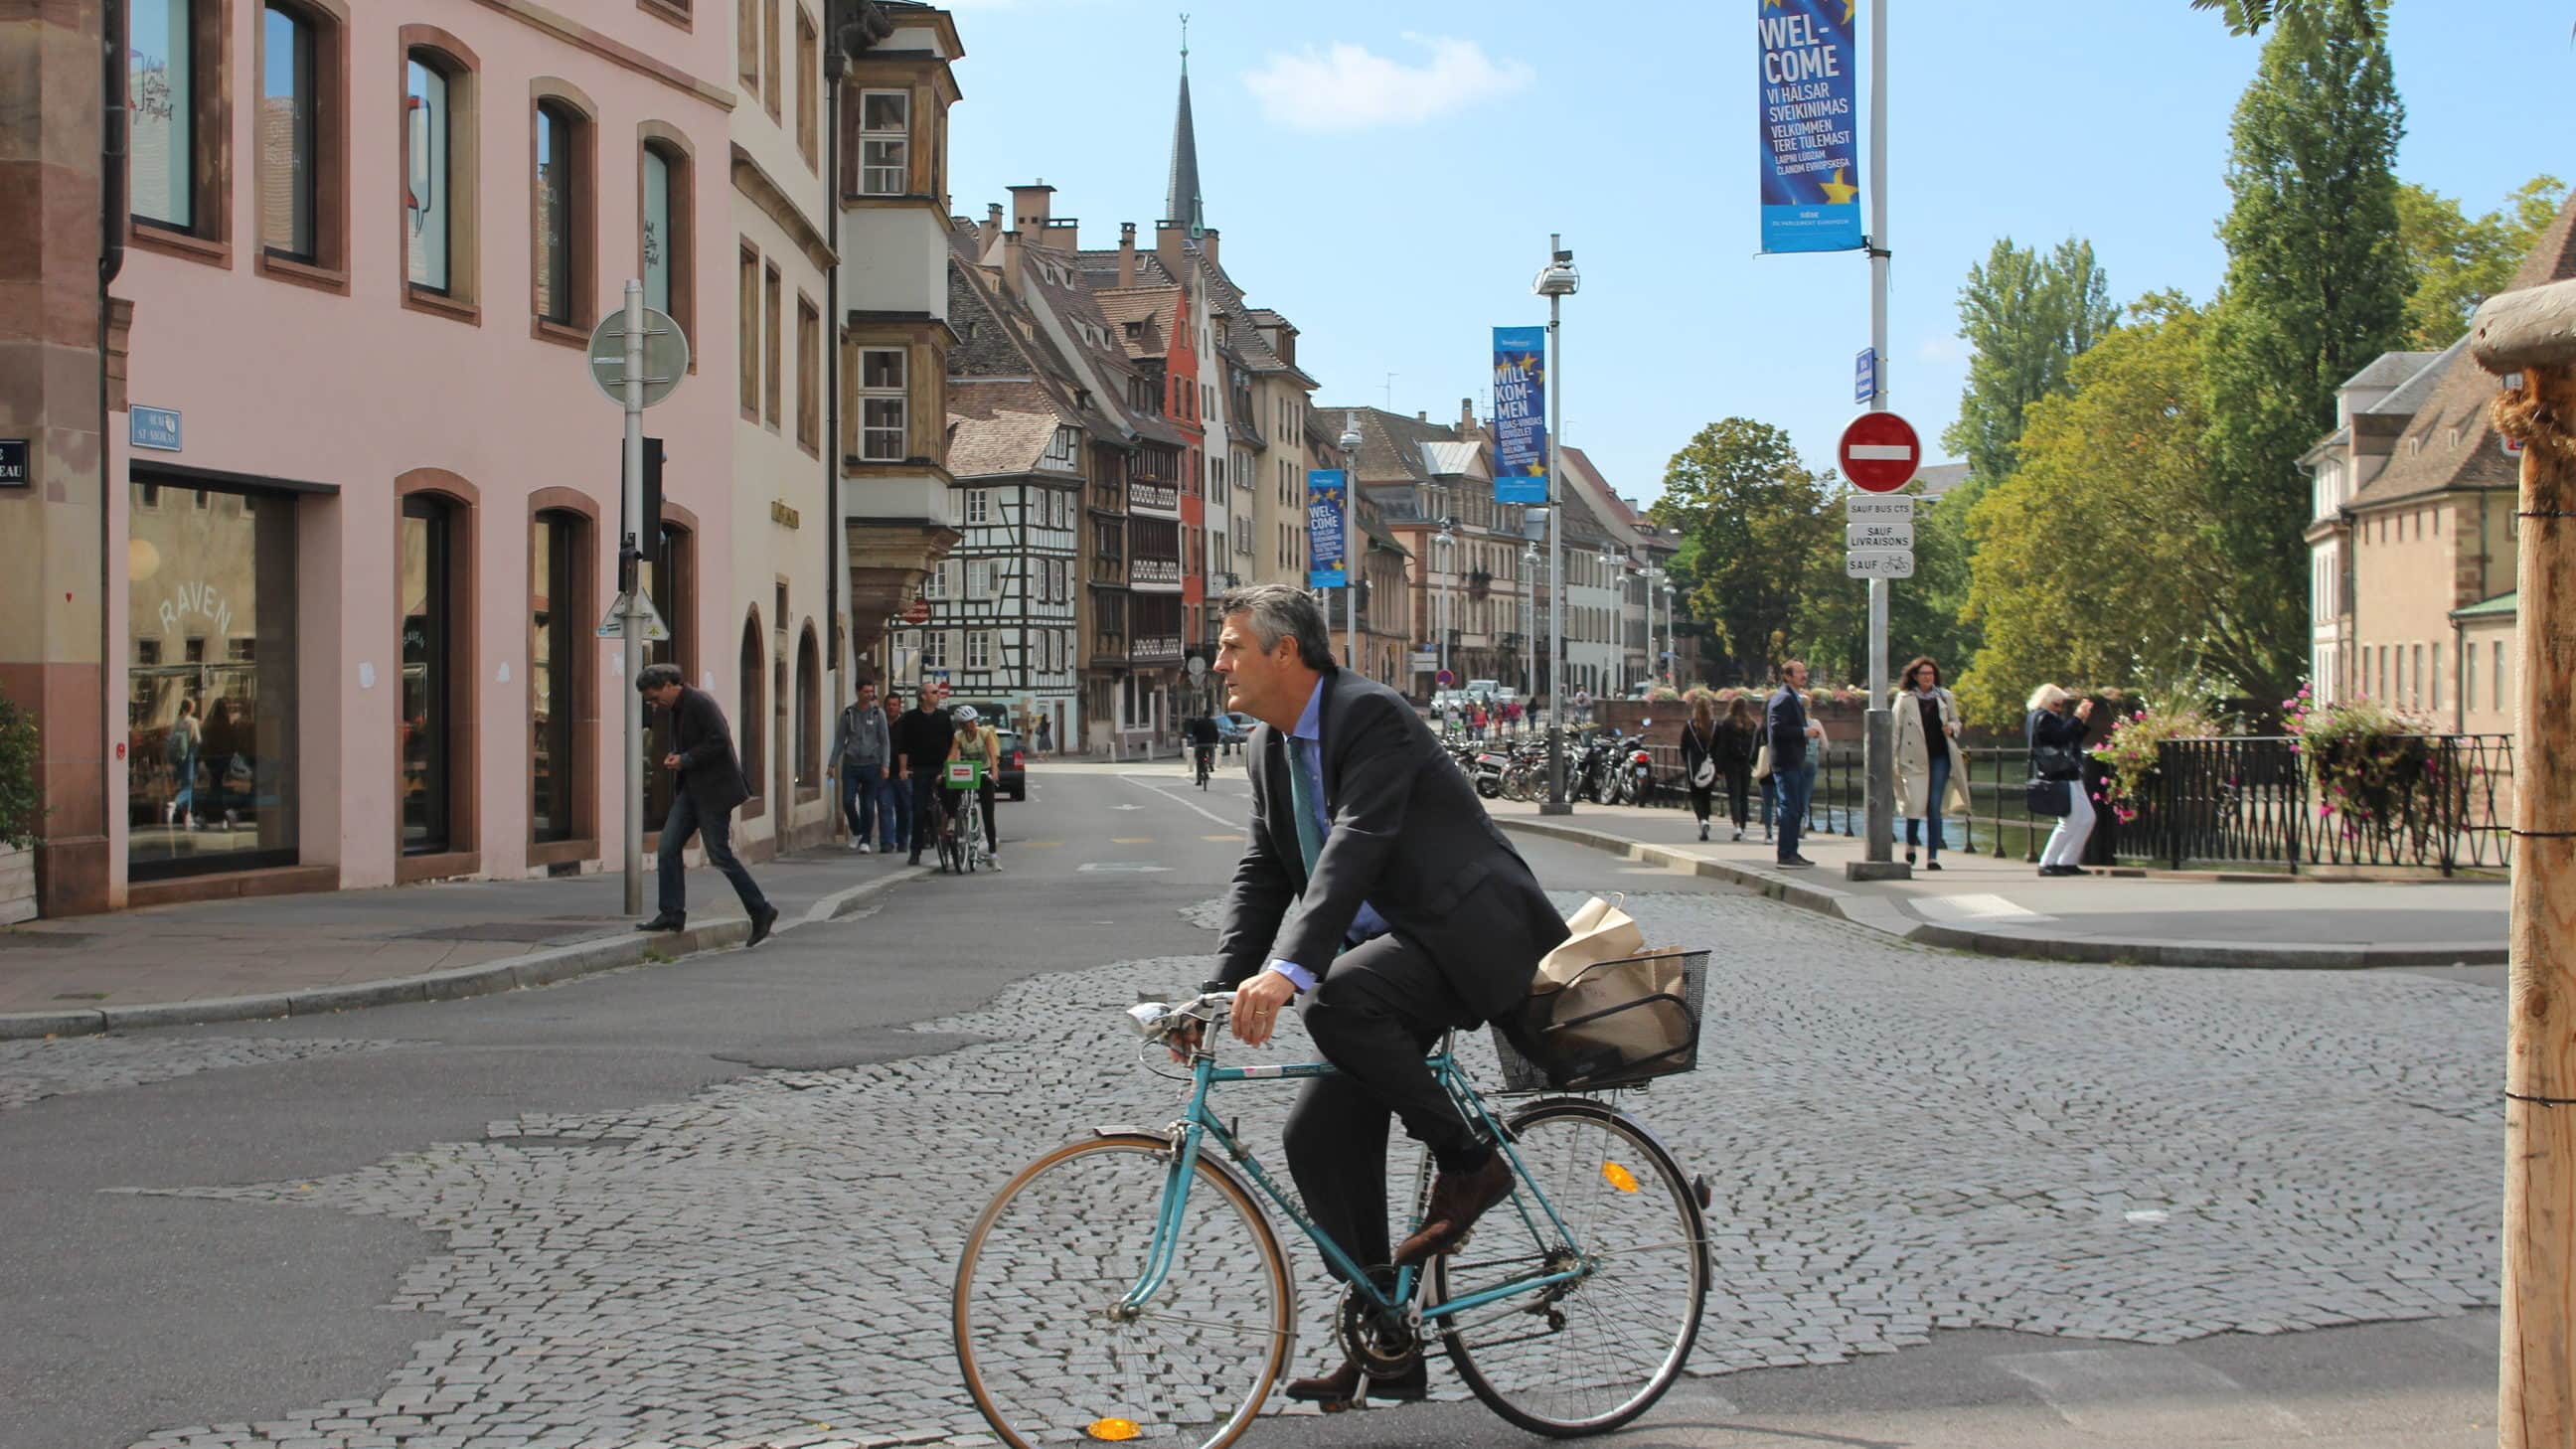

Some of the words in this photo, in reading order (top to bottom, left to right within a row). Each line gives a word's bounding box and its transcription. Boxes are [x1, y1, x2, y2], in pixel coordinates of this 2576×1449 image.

[1759, 14, 1830, 50] WEL-
[1764, 45, 1840, 84] COME
[1766, 87, 1779, 104] VI
[1769, 97, 1849, 122] SVEIKINIMAS
[1770, 118, 1833, 138] VELKOMMEN
[1772, 137, 1798, 152] TERE
[1799, 130, 1851, 149] TULEMAST
[1494, 366, 1534, 385] WILL-
[1495, 383, 1533, 402] KOM-
[1497, 400, 1529, 419] MEN
[1312, 516, 1339, 530] COME
[1852, 538, 1909, 547] LIVRAISONS
[1850, 561, 1877, 569] SAUF
[159, 580, 232, 635] RAVEN
